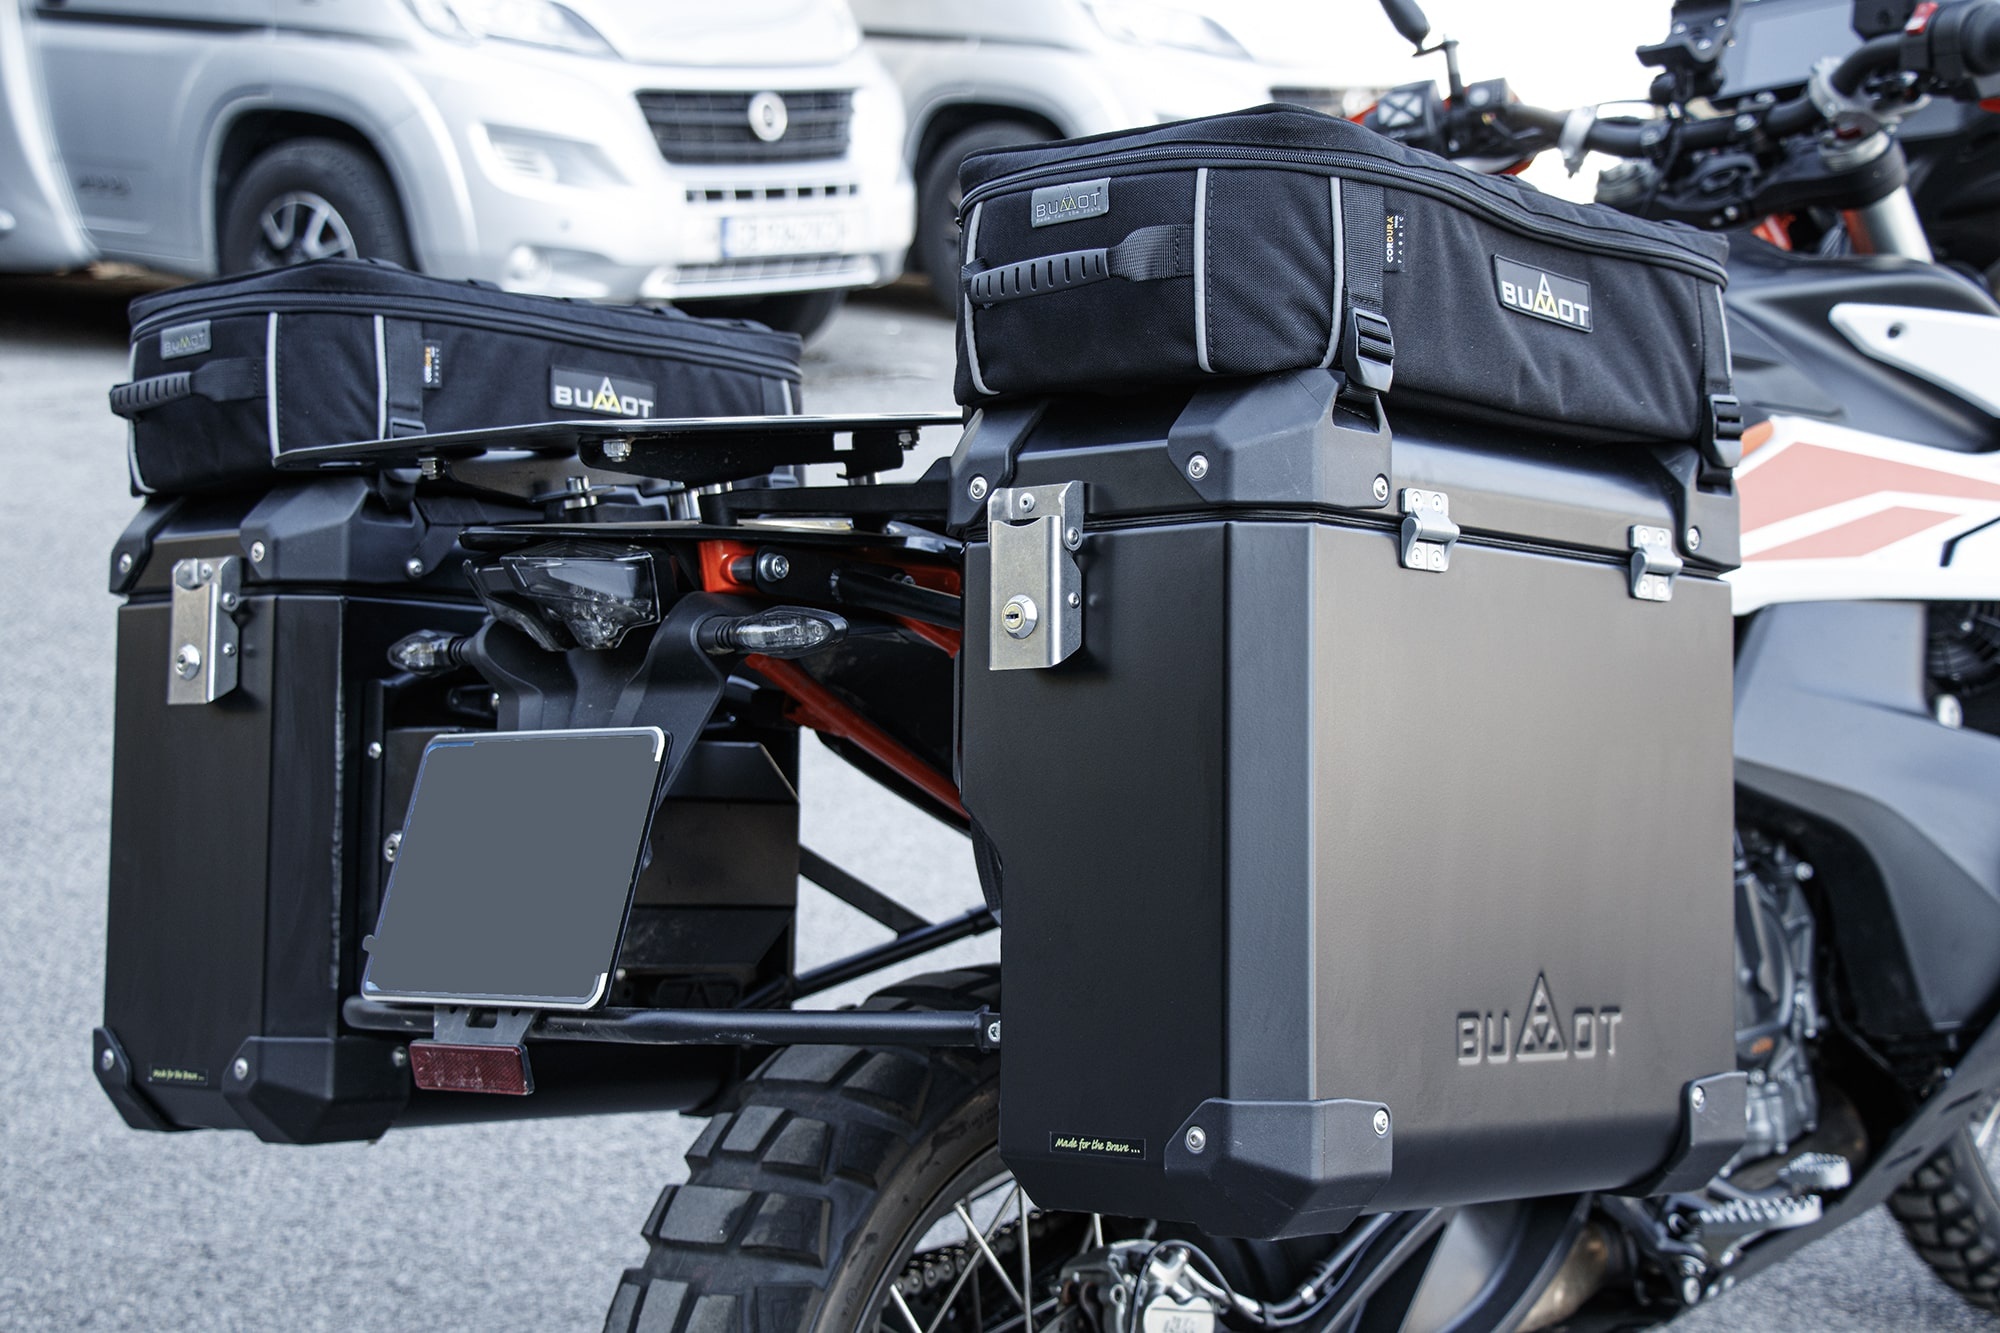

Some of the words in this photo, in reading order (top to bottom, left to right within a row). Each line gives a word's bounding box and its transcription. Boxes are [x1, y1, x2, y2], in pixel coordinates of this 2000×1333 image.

[1386, 215, 1394, 263] CORDURA
[1501, 273, 1590, 326] BUMOT
[554, 376, 655, 419] BUMOT
[1456, 967, 1622, 1066] BUMOT
[1055, 1137, 1078, 1149] Made
[1078, 1138, 1091, 1151] for
[1091, 1139, 1105, 1151] the
[1105, 1141, 1130, 1153] Brave
